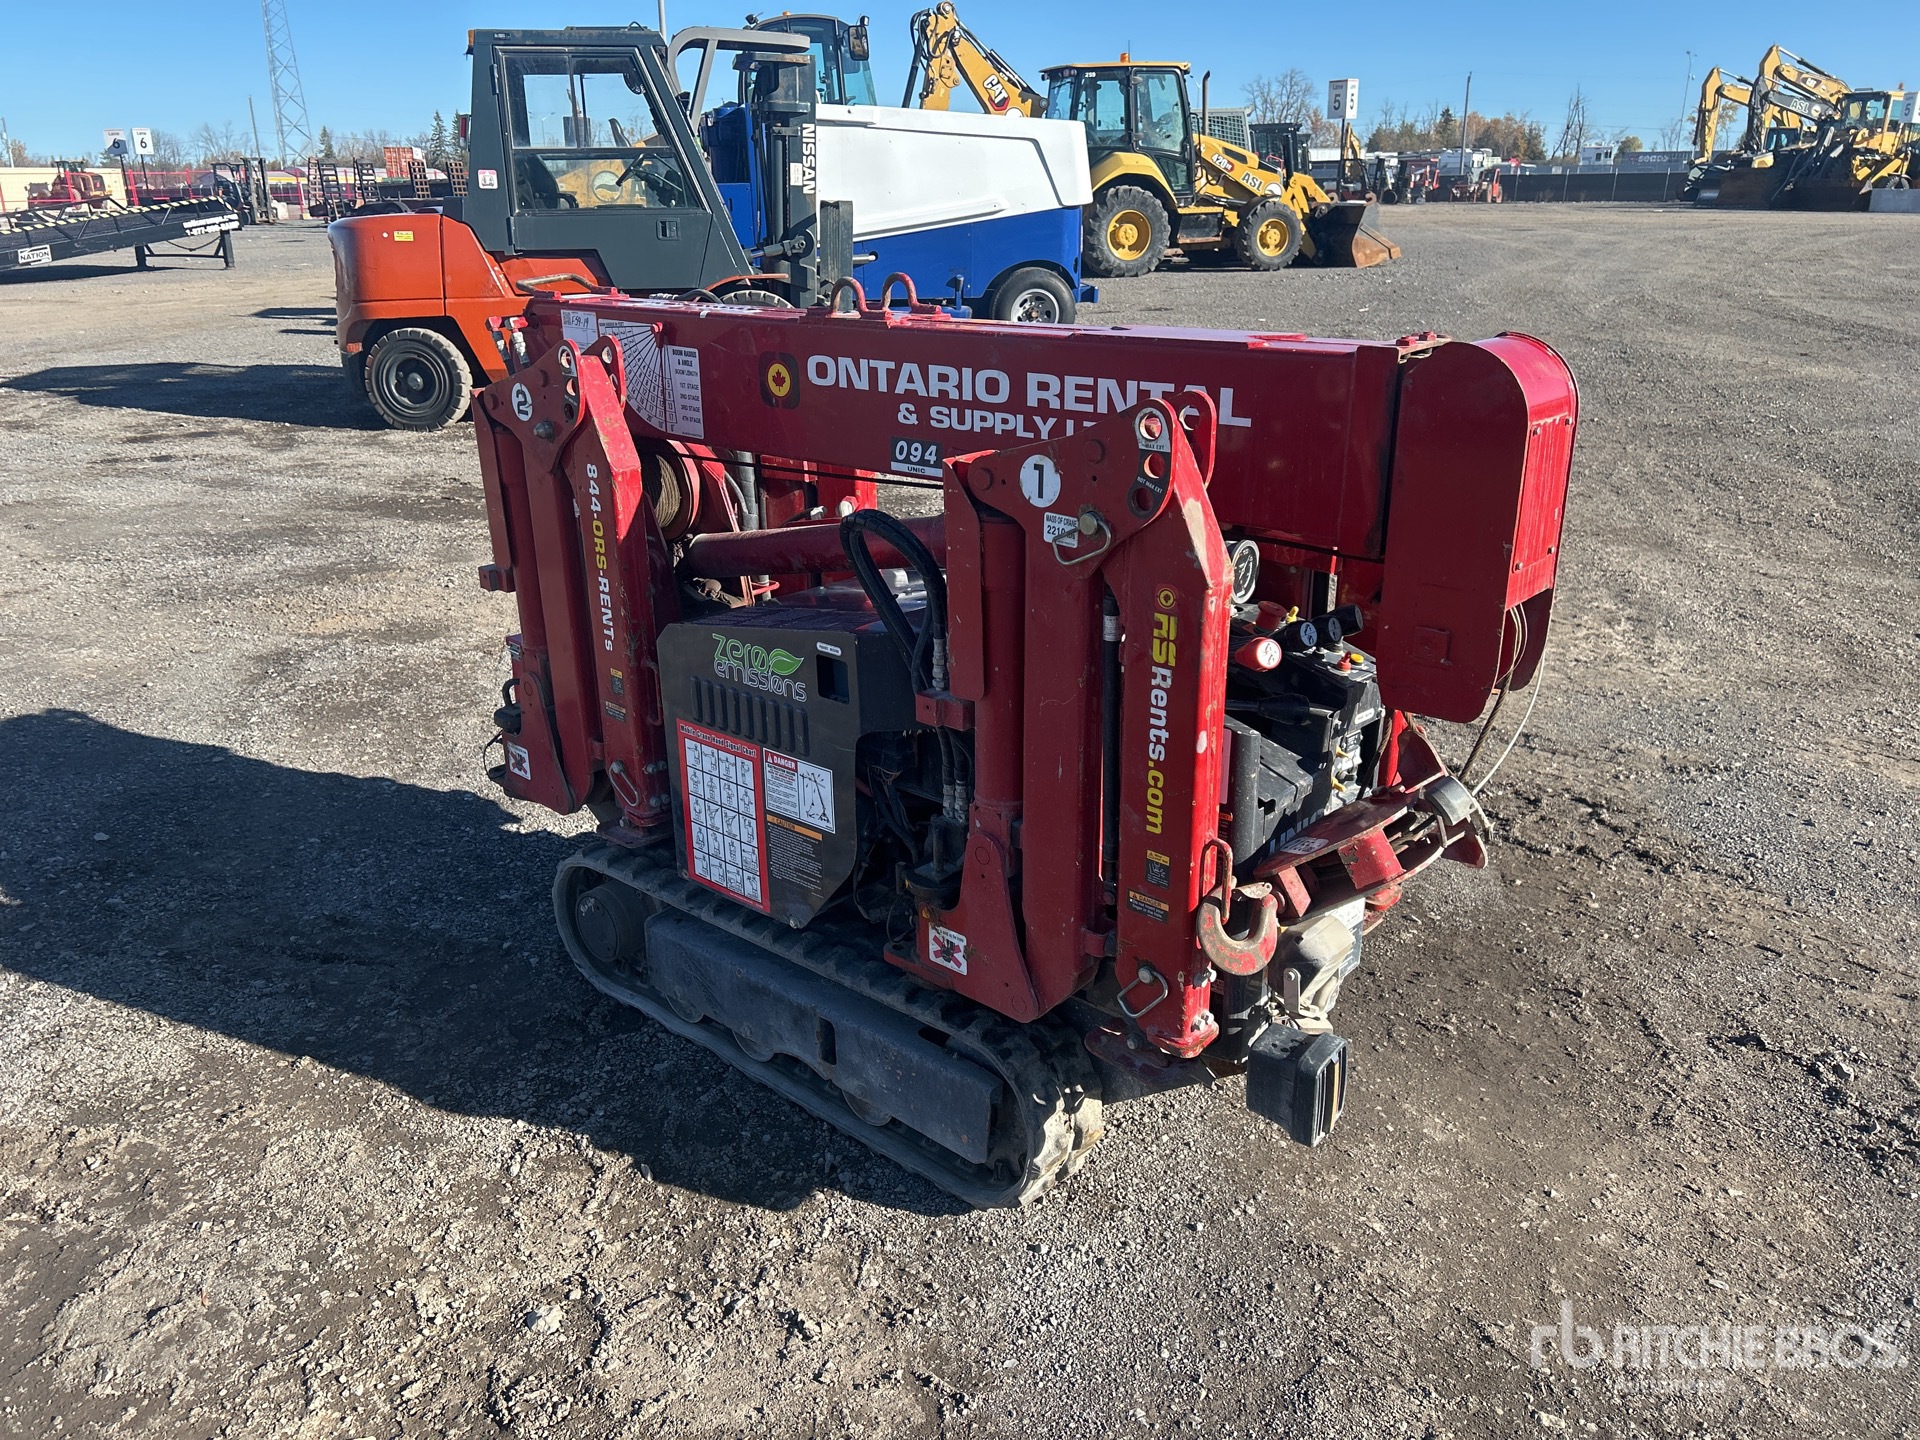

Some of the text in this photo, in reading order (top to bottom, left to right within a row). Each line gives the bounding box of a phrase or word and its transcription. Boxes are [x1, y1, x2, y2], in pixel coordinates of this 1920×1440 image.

[983, 75, 1009, 104] CAT
[1333, 93, 1341, 111] 5
[1790, 98, 1809, 114] ASL
[1904, 102, 1912, 116] 5
[112, 138, 120, 149] 6
[140, 138, 148, 149] 6
[802, 123, 816, 195] NISSAN
[1241, 171, 1265, 192] ASL
[20, 250, 50, 261] NATION
[806, 354, 1253, 428] ONTARIO RENTL
[516, 389, 528, 416] 2
[898, 403, 918, 426] &
[929, 406, 1057, 441] SUPPLY
[896, 440, 937, 464] 094
[1034, 464, 1044, 499] 1
[1046, 514, 1077, 528] MASS OF CRANE
[1047, 525, 1066, 536] 2210
[712, 633, 770, 673] zero
[714, 659, 807, 702] emissions
[680, 724, 757, 758] Mobile Crane Hand Signal Chart
[774, 756, 796, 770] DANGER
[776, 818, 796, 830] CAUTION
